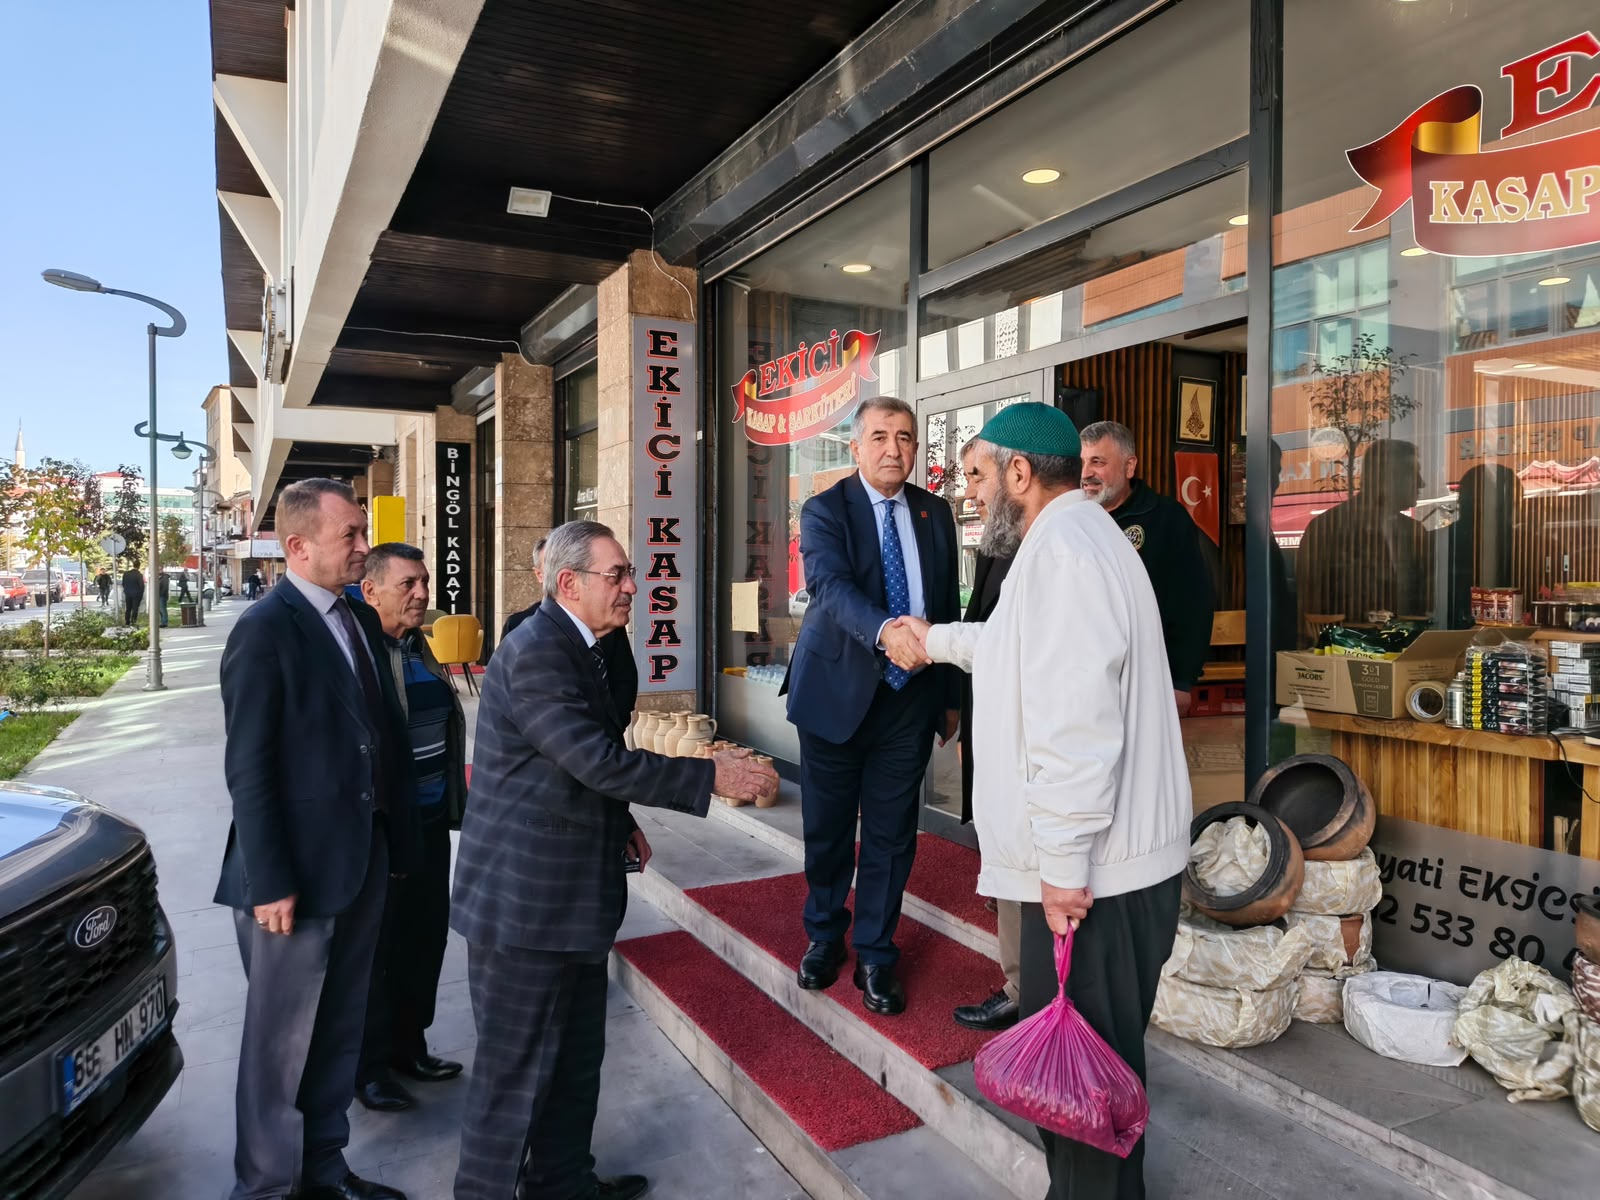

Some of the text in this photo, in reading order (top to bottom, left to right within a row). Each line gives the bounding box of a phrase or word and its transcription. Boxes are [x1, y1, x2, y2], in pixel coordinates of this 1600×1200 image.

[1429, 165, 1600, 224] KASAP
[758, 329, 841, 397] EKİCİ
[746, 372, 857, 436] KASAP & ŞARKÜTERİ
[446, 448, 460, 528] BİNGÖL
[646, 329, 682, 682] EKİCİ KASAP
[1296, 672, 1323, 681] JACOBS
[1376, 854, 1444, 889] yati
[85, 911, 109, 943] Ford
[1371, 895, 1398, 925] 2
[1410, 903, 1475, 947] 533
[1489, 926, 1545, 966] 80
[115, 1014, 134, 1062] HN
[139, 986, 164, 1035] 970
